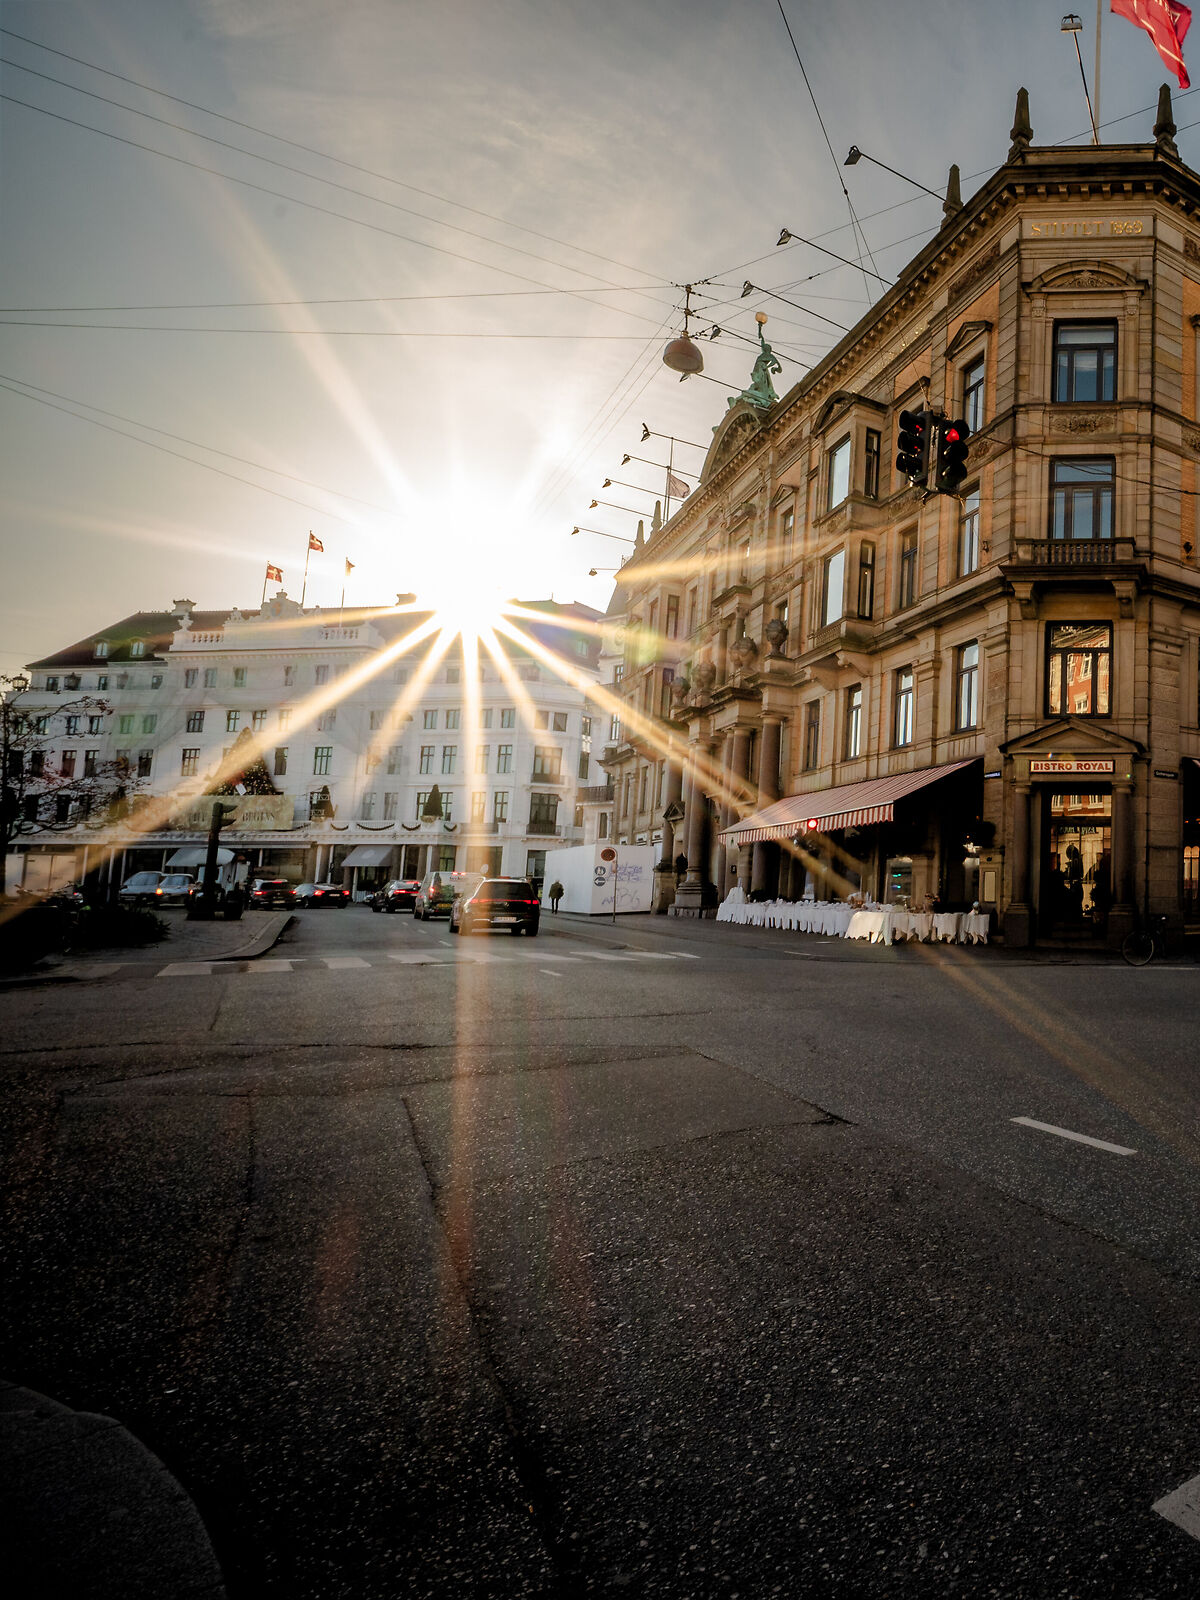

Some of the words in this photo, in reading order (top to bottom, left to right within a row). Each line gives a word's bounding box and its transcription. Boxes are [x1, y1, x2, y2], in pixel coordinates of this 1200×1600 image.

[1031, 221, 1104, 237] STIFTET
[1110, 219, 1143, 235] 1869
[1033, 762, 1073, 771] BISTRO
[1076, 762, 1111, 771] ROYAL
